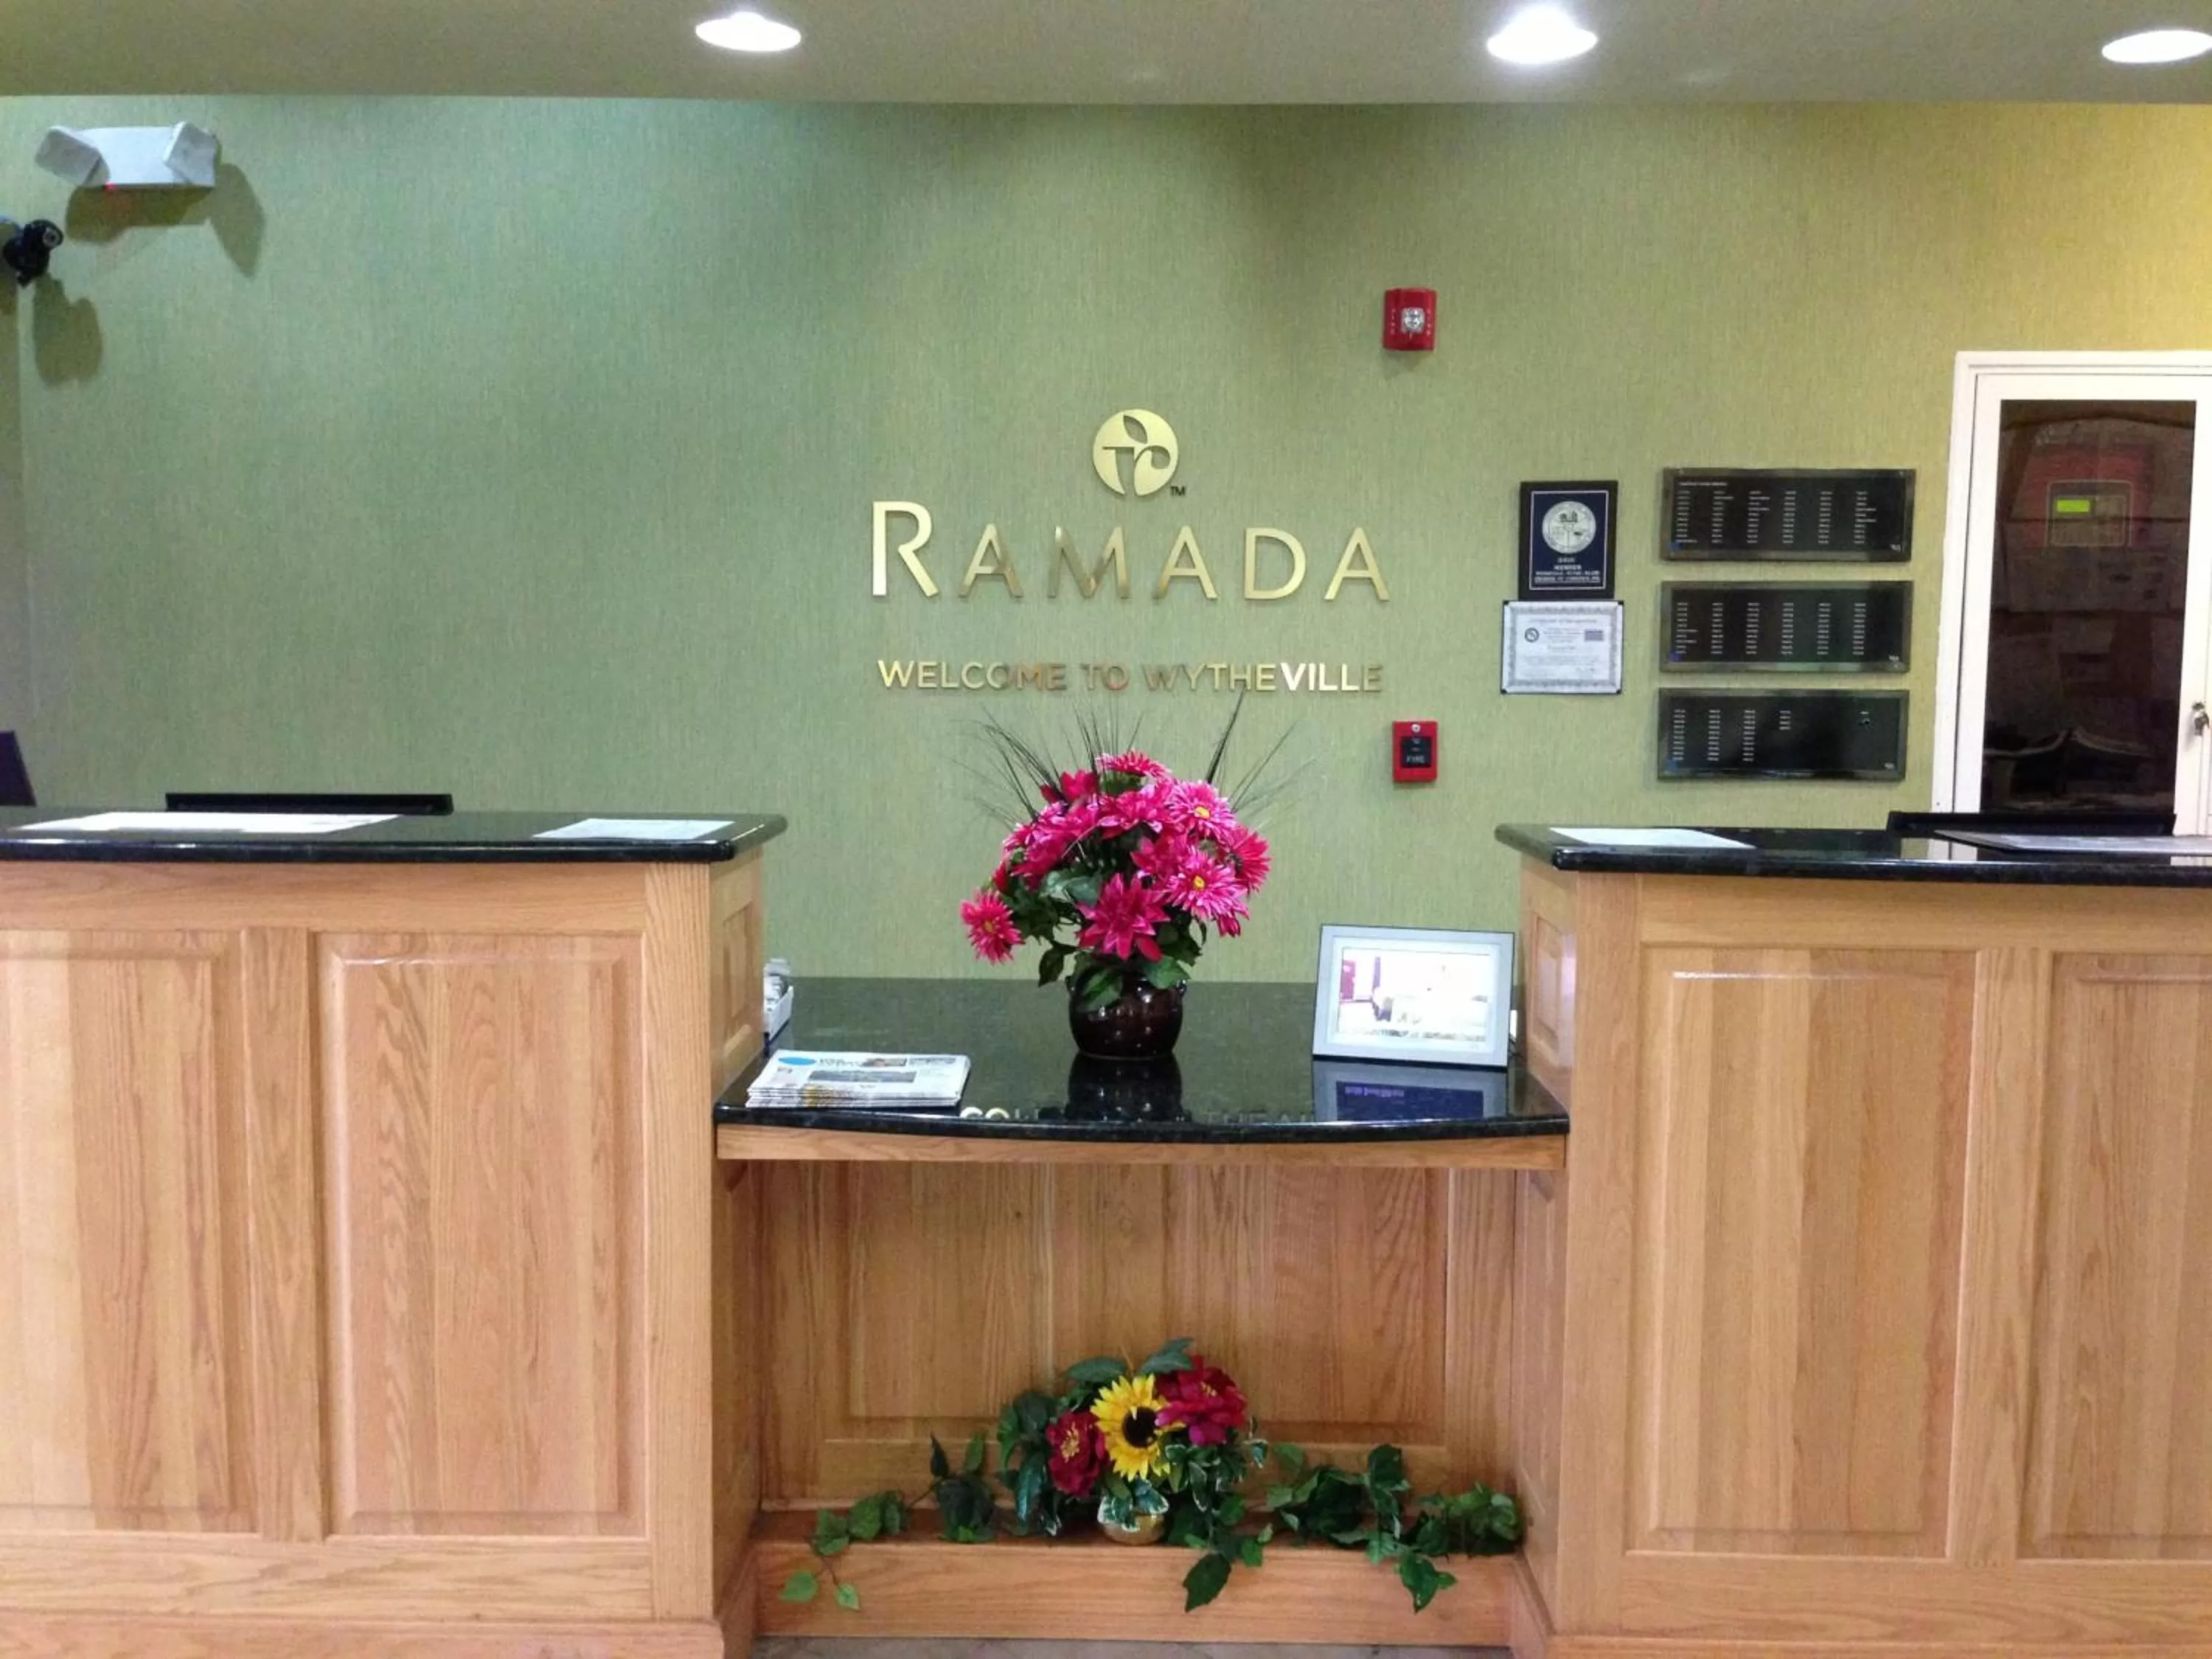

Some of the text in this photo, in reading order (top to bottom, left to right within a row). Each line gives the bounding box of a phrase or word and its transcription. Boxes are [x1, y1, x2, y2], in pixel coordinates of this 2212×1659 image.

[872, 501, 1389, 601] RAMADA
[877, 660, 1383, 692] WELCOME TO WYTHEVILLE
